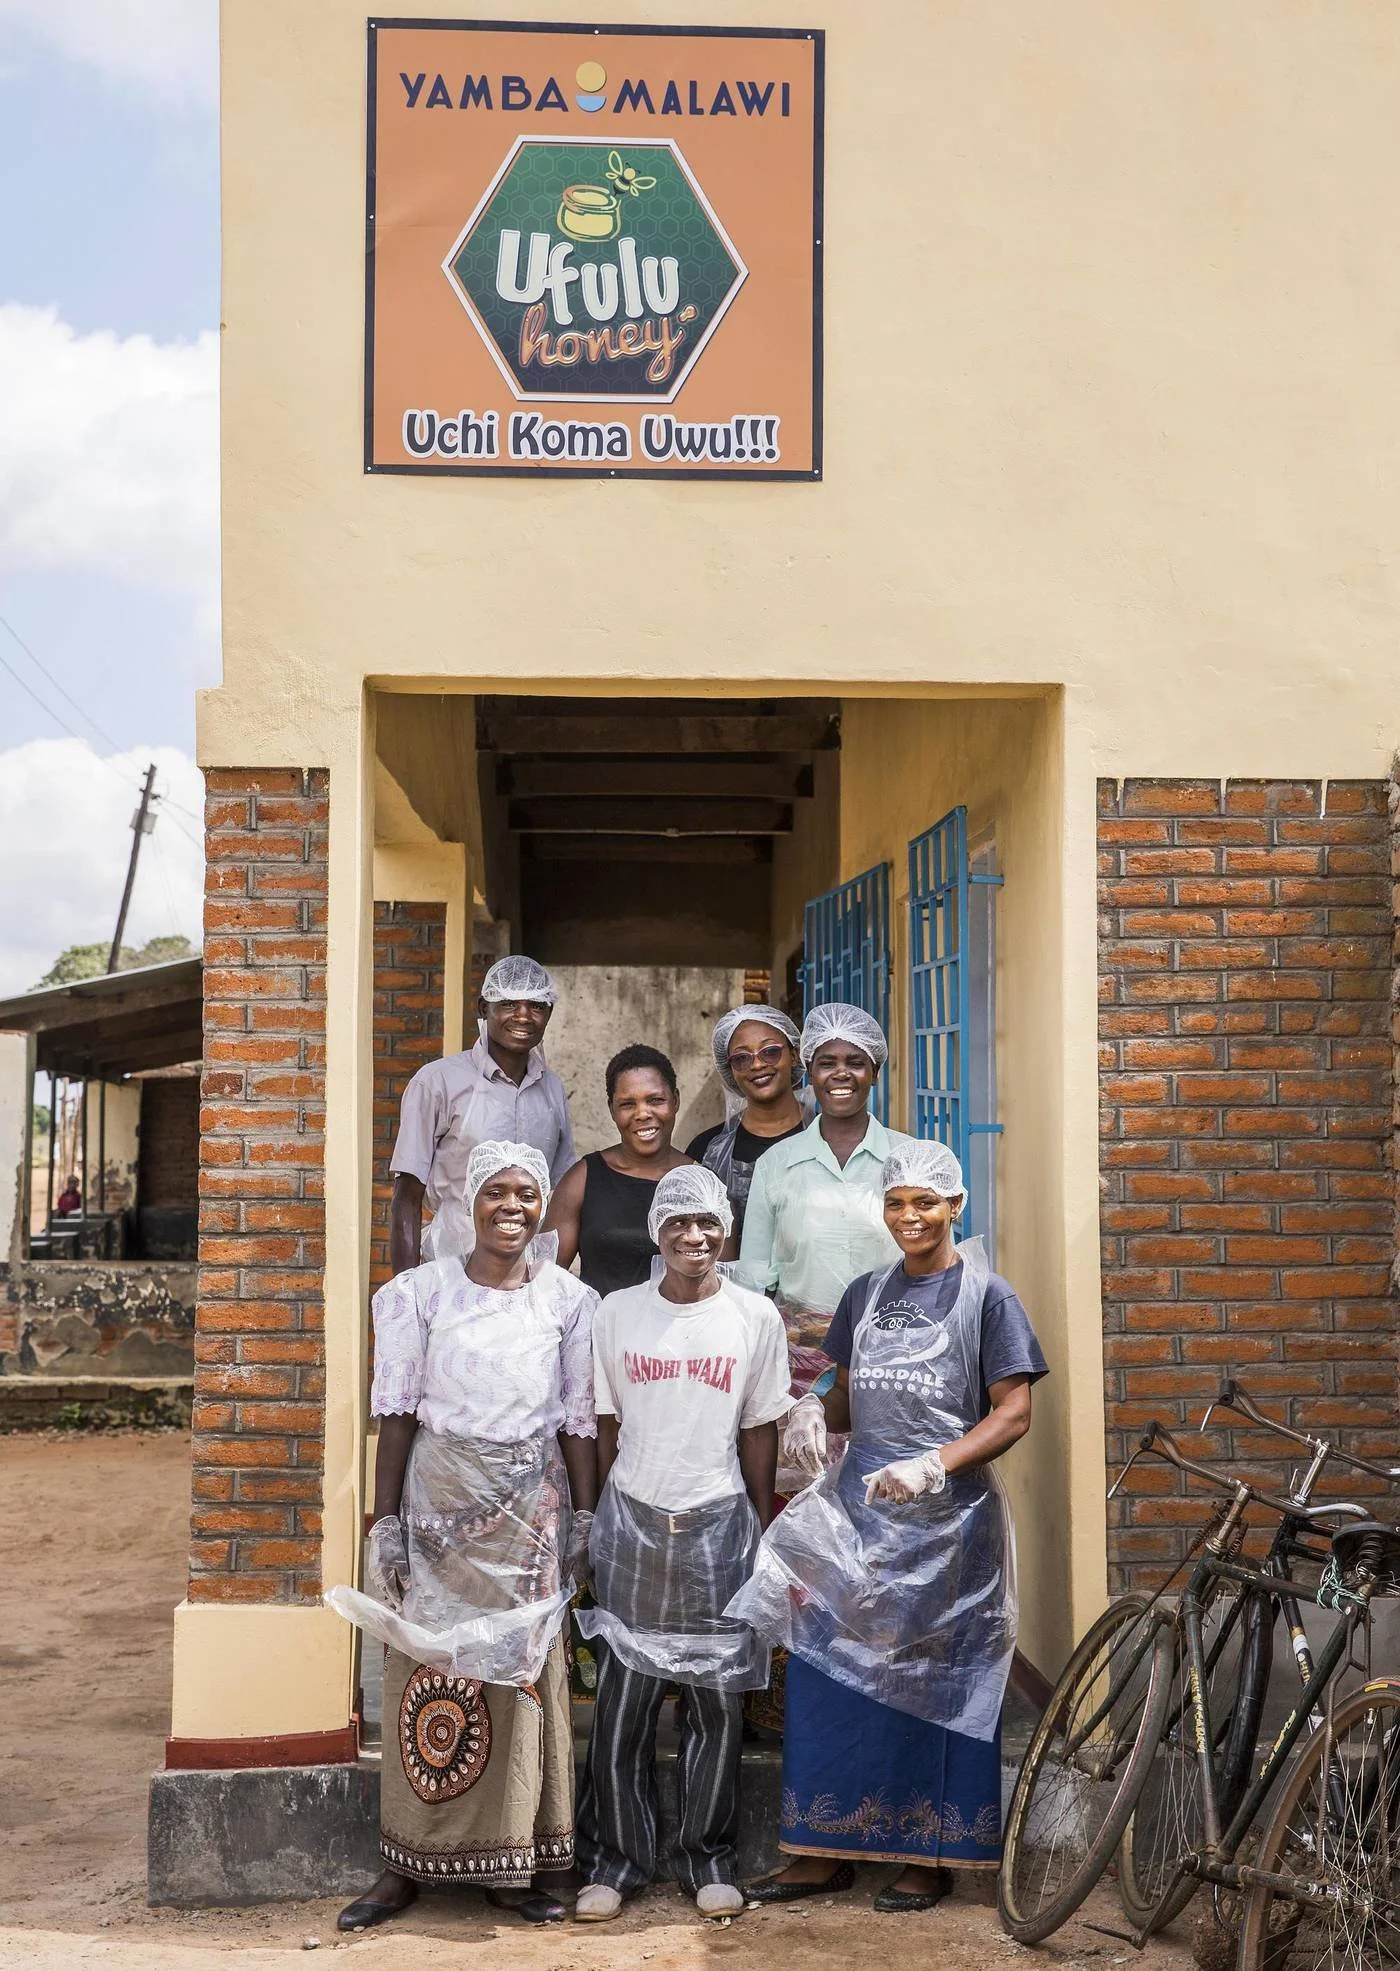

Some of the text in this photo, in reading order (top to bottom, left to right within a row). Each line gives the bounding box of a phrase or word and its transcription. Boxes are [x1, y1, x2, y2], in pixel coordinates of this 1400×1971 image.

[399, 72, 791, 117] YAMBA MALAWI
[495, 229, 681, 325] Ufulu
[518, 303, 690, 384] honey
[405, 412, 779, 461] Uchi Koma Uwu!!!
[686, 1355, 737, 1394] WALK
